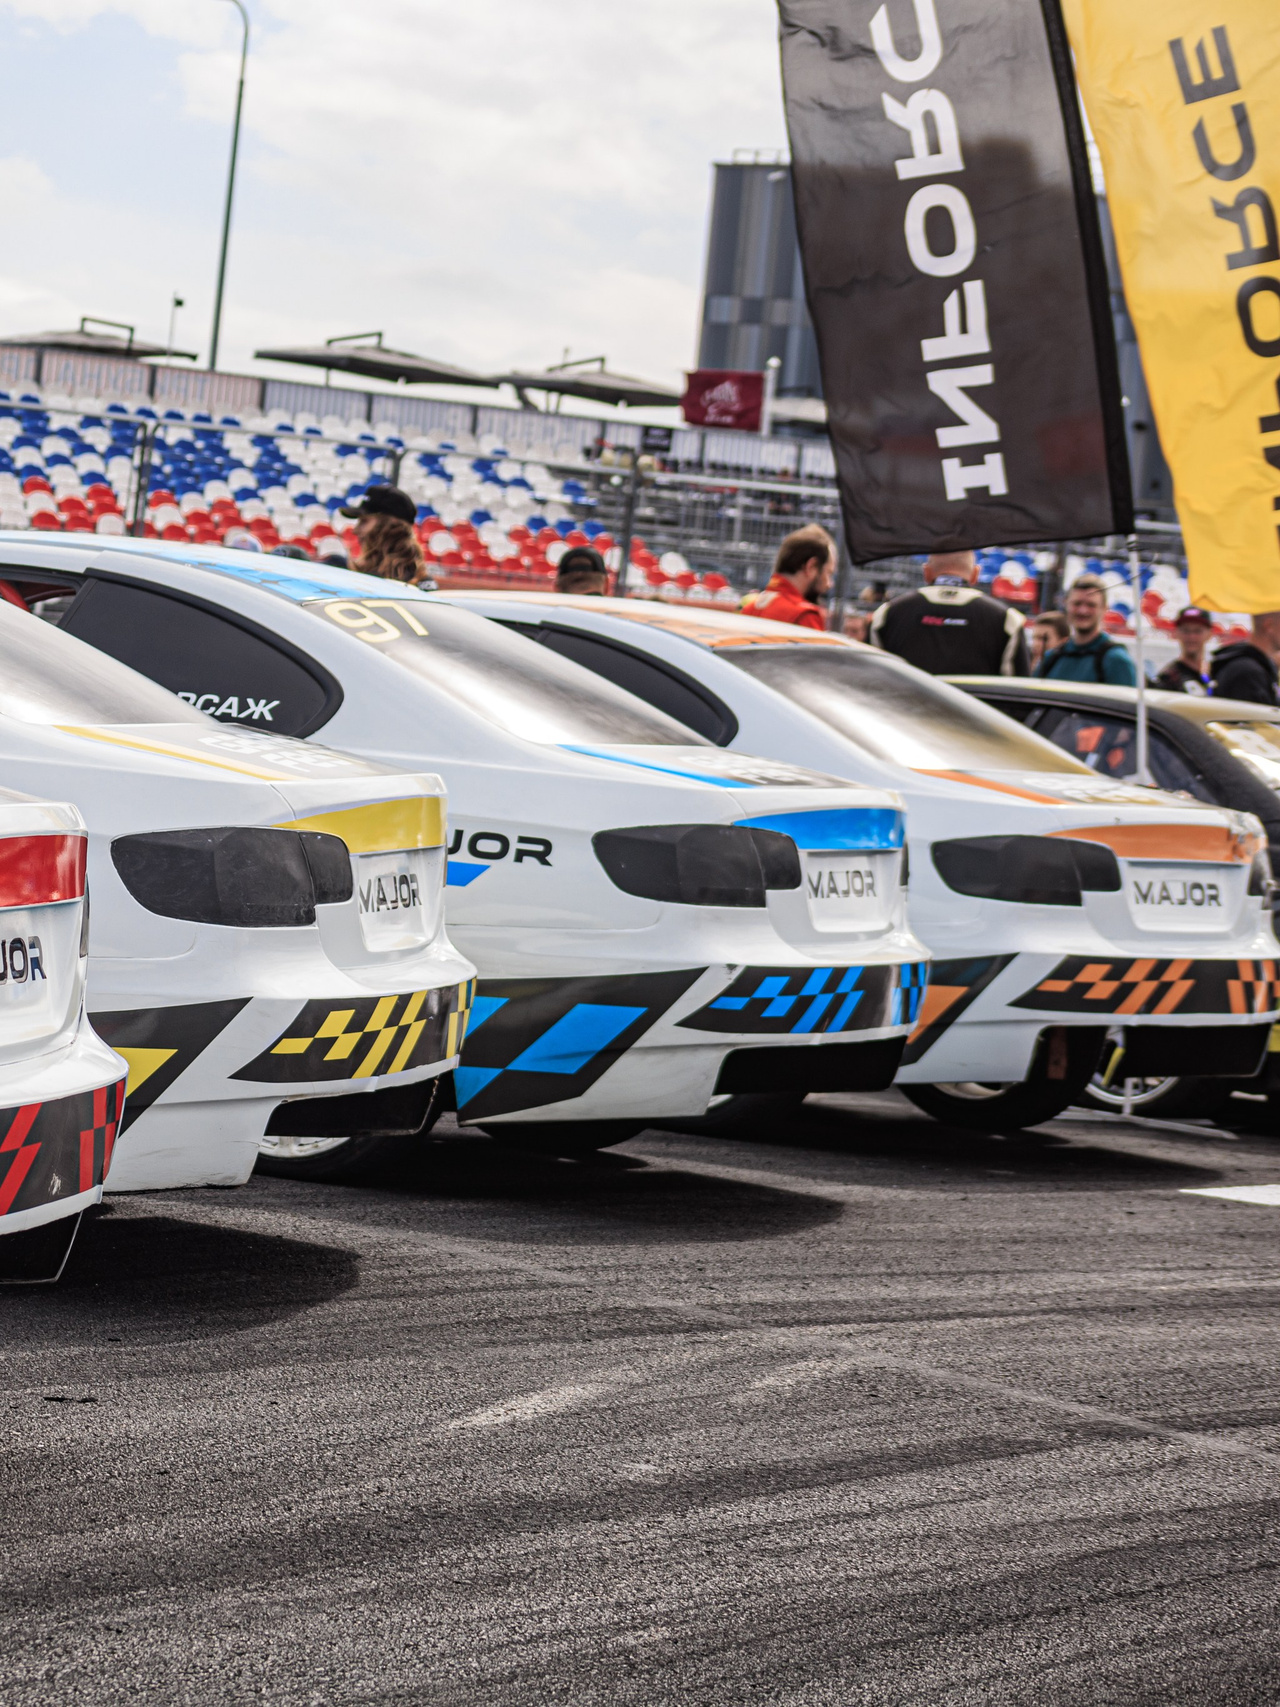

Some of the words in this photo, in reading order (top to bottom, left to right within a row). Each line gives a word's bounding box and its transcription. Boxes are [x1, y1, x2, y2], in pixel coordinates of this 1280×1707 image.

[324, 600, 429, 643] 97
[359, 873, 422, 914] MAJOR
[807, 869, 877, 899] MAJOR
[1133, 880, 1222, 907] MAJOR
